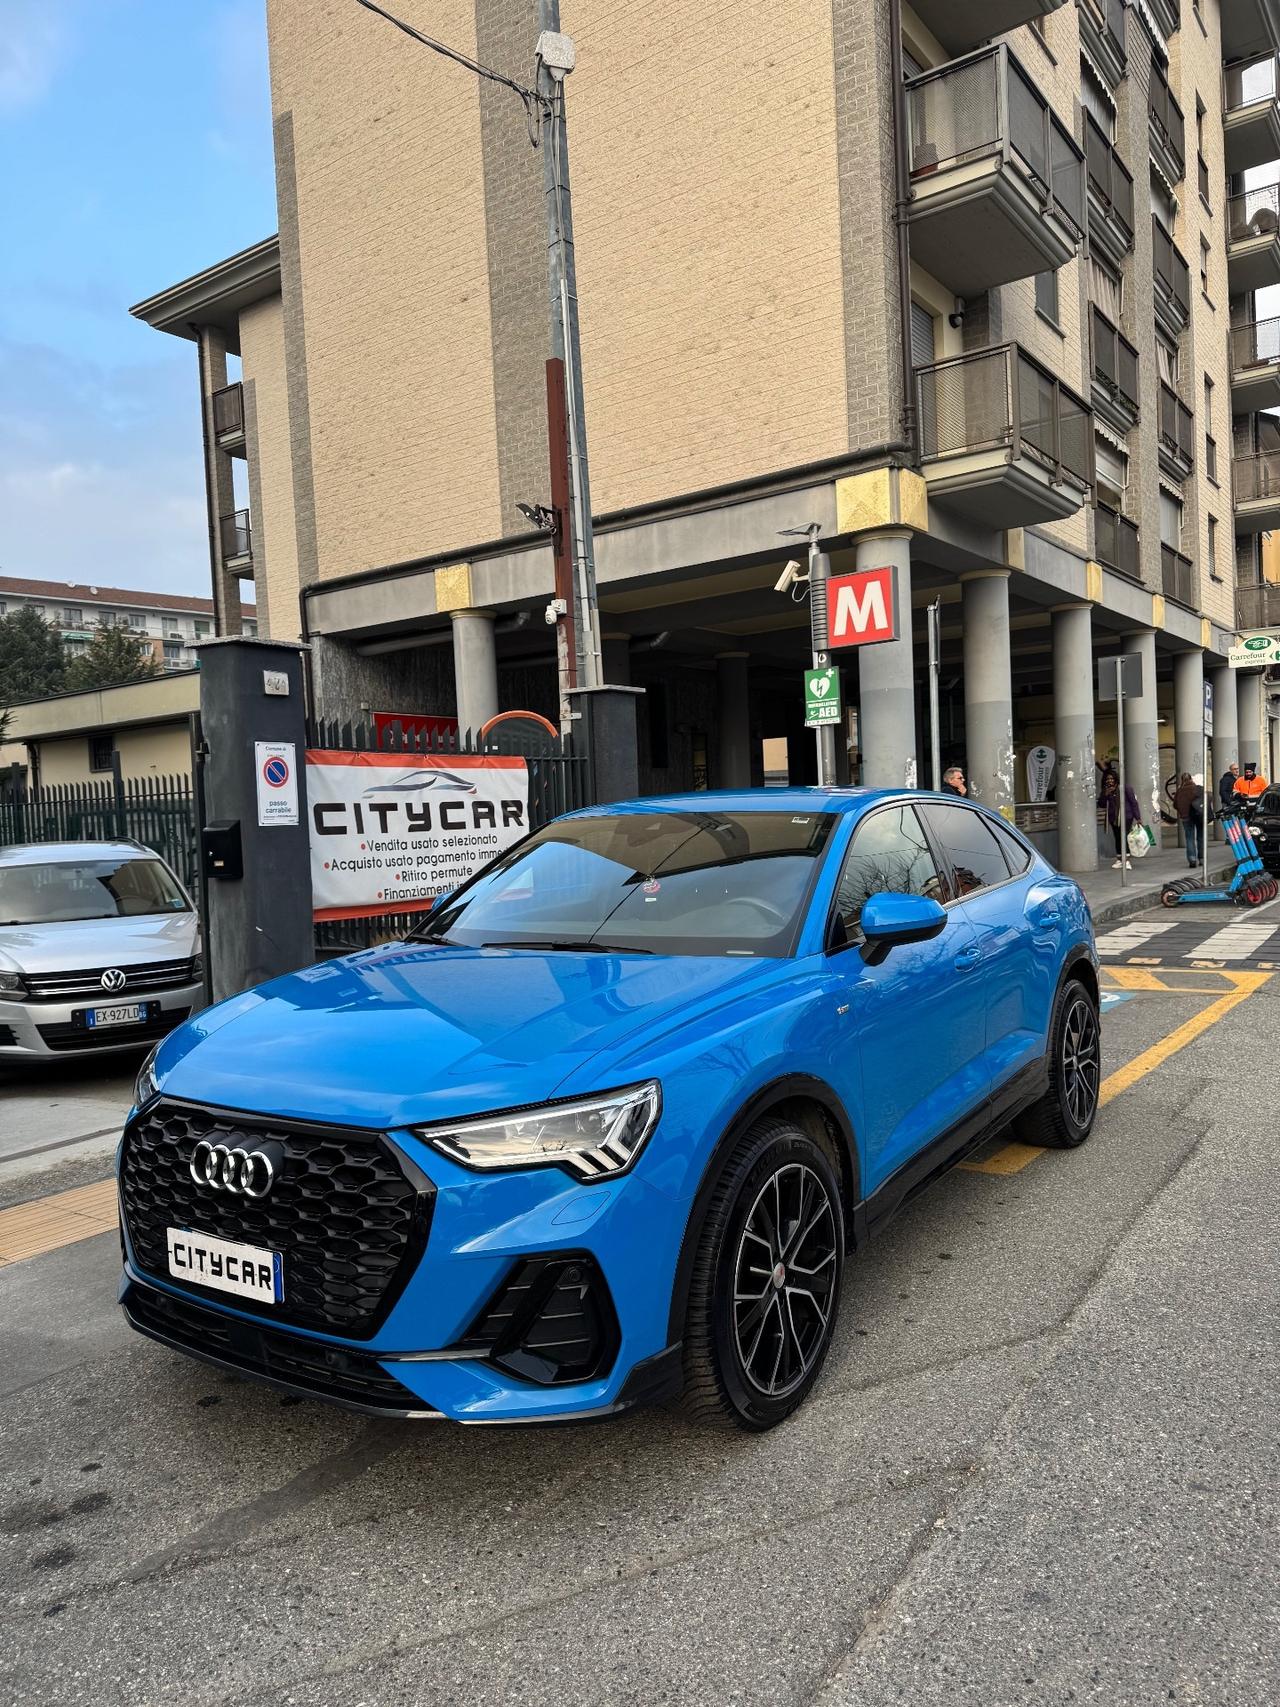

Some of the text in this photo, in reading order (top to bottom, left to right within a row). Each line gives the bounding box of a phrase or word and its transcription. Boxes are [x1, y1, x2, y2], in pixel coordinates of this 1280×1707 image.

[834, 580, 889, 637] M
[1230, 652, 1266, 662] Carrefour
[819, 706, 838, 718] AED
[265, 806, 292, 814] carrabile
[313, 800, 525, 836] CITYCAR
[367, 834, 498, 852] Vendita usato selezionato
[331, 856, 383, 872] Acquisto
[385, 855, 413, 868] usato
[416, 850, 476, 867] pagamento
[401, 866, 473, 882] Ritiro permute
[384, 882, 455, 901] Finanziamenti
[174, 1242, 272, 1291] CITYCAR
